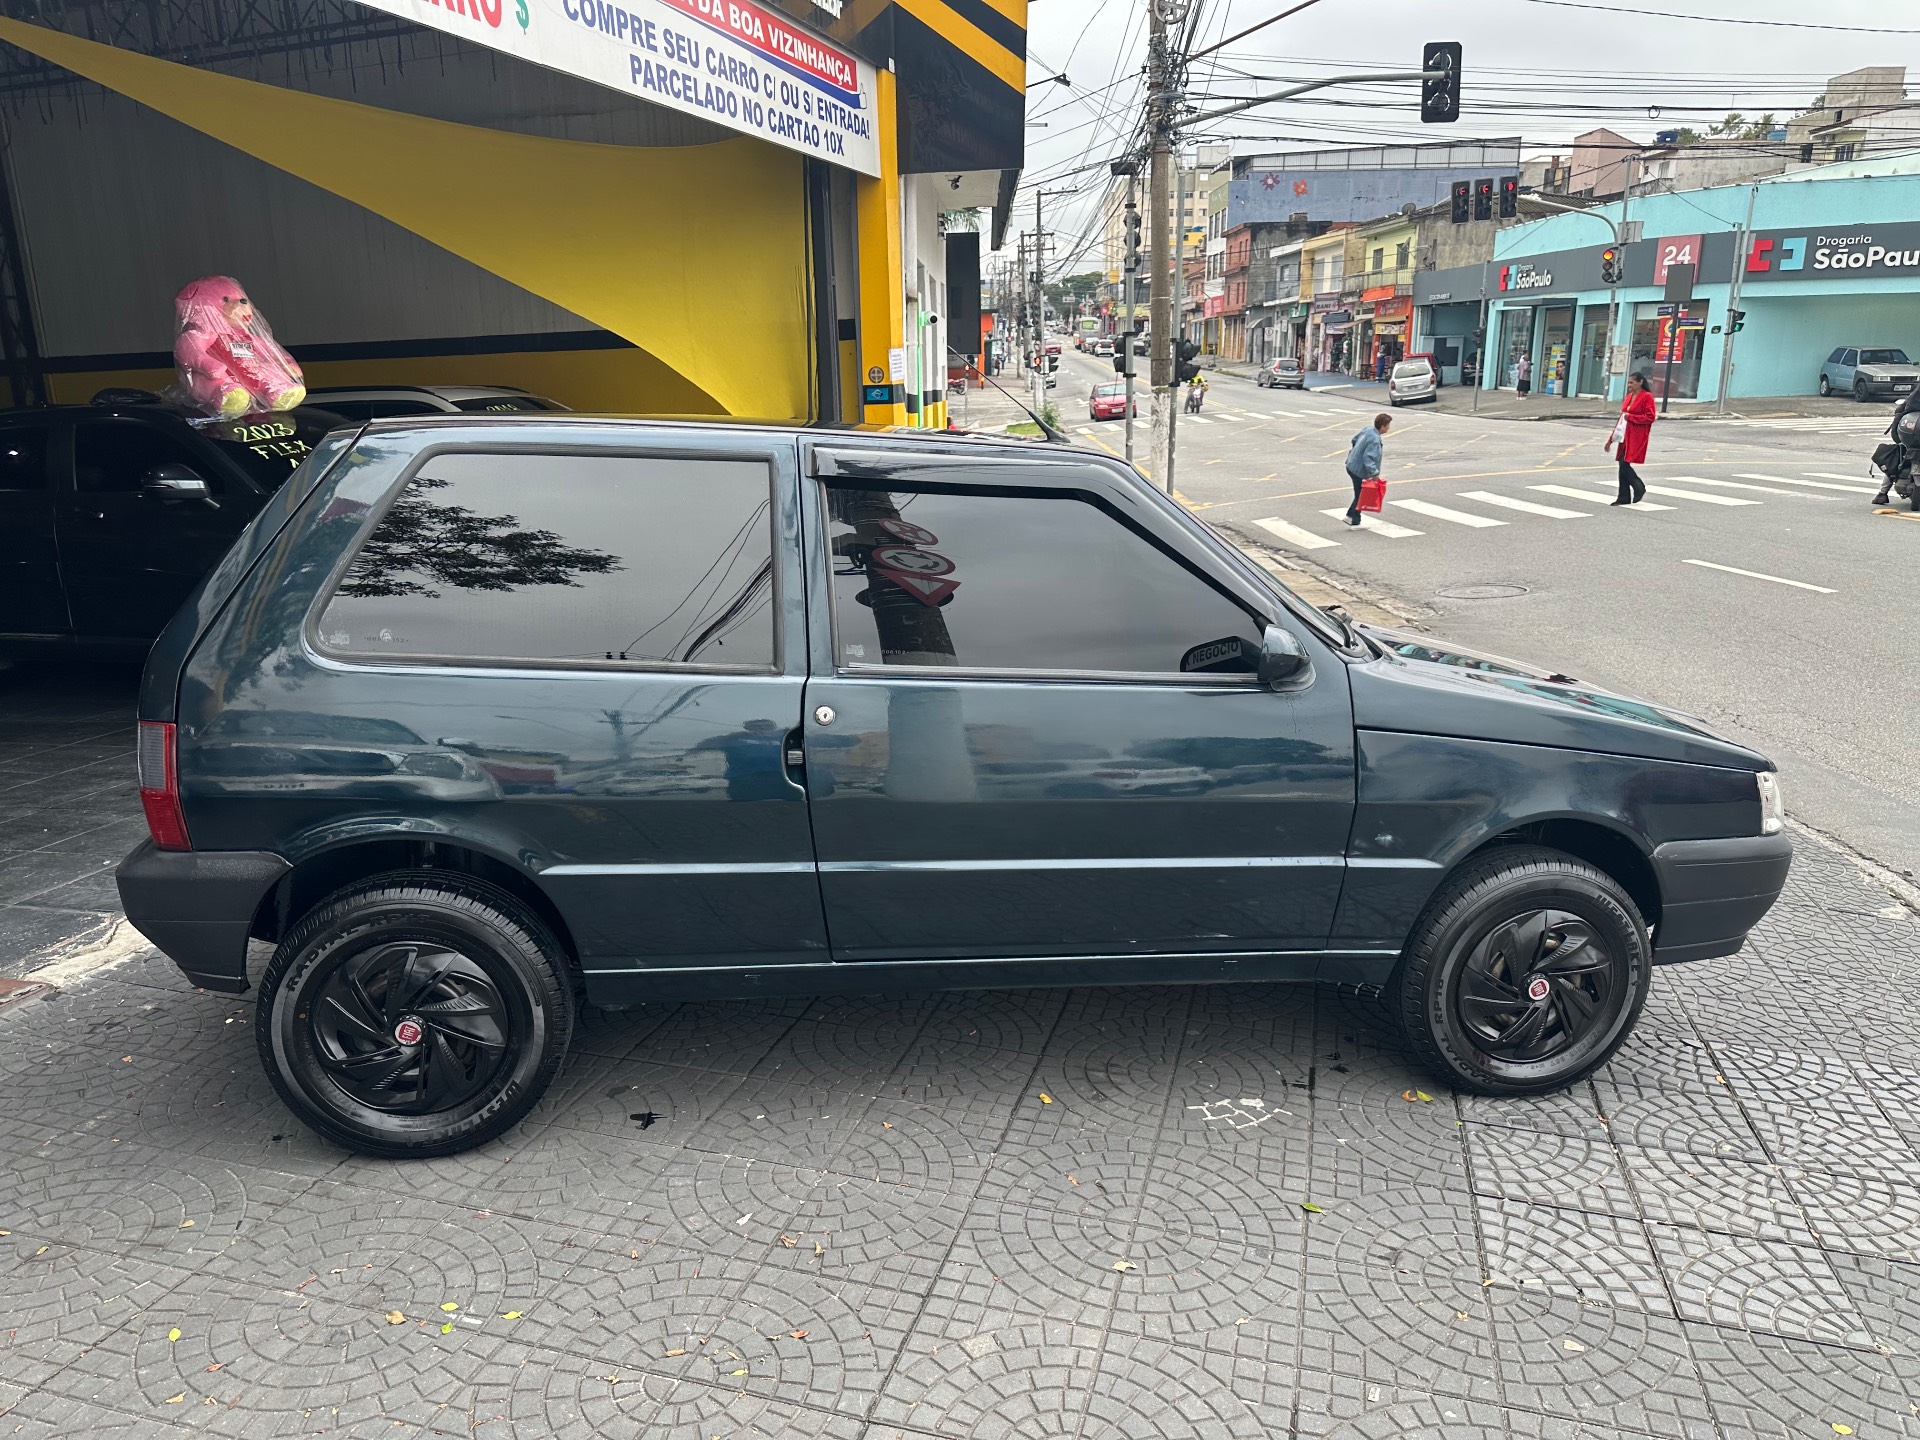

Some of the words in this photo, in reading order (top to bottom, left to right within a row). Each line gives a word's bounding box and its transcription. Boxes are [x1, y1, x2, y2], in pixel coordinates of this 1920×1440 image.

[728, 3, 764, 43] BOA
[768, 24, 852, 86] VIZINHANÇA
[563, 0, 658, 53] COMPRE
[663, 28, 700, 69] SEU
[705, 47, 759, 93] CARRO
[780, 81, 799, 110] OU
[817, 97, 870, 140] ENTRADA!
[629, 53, 738, 119] PARCELADO
[742, 96, 764, 128] NO
[768, 107, 820, 148] CARTAO
[823, 129, 845, 157] 10X
[1817, 235, 1872, 247] Drogaria
[1662, 244, 1691, 266] 24
[1516, 269, 1552, 289] SãoPaulo
[233, 422, 295, 442] 2023
[249, 440, 313, 460] FLEX
[1192, 640, 1239, 664] NEGOCIO
[285, 925, 360, 992] RADIAL
